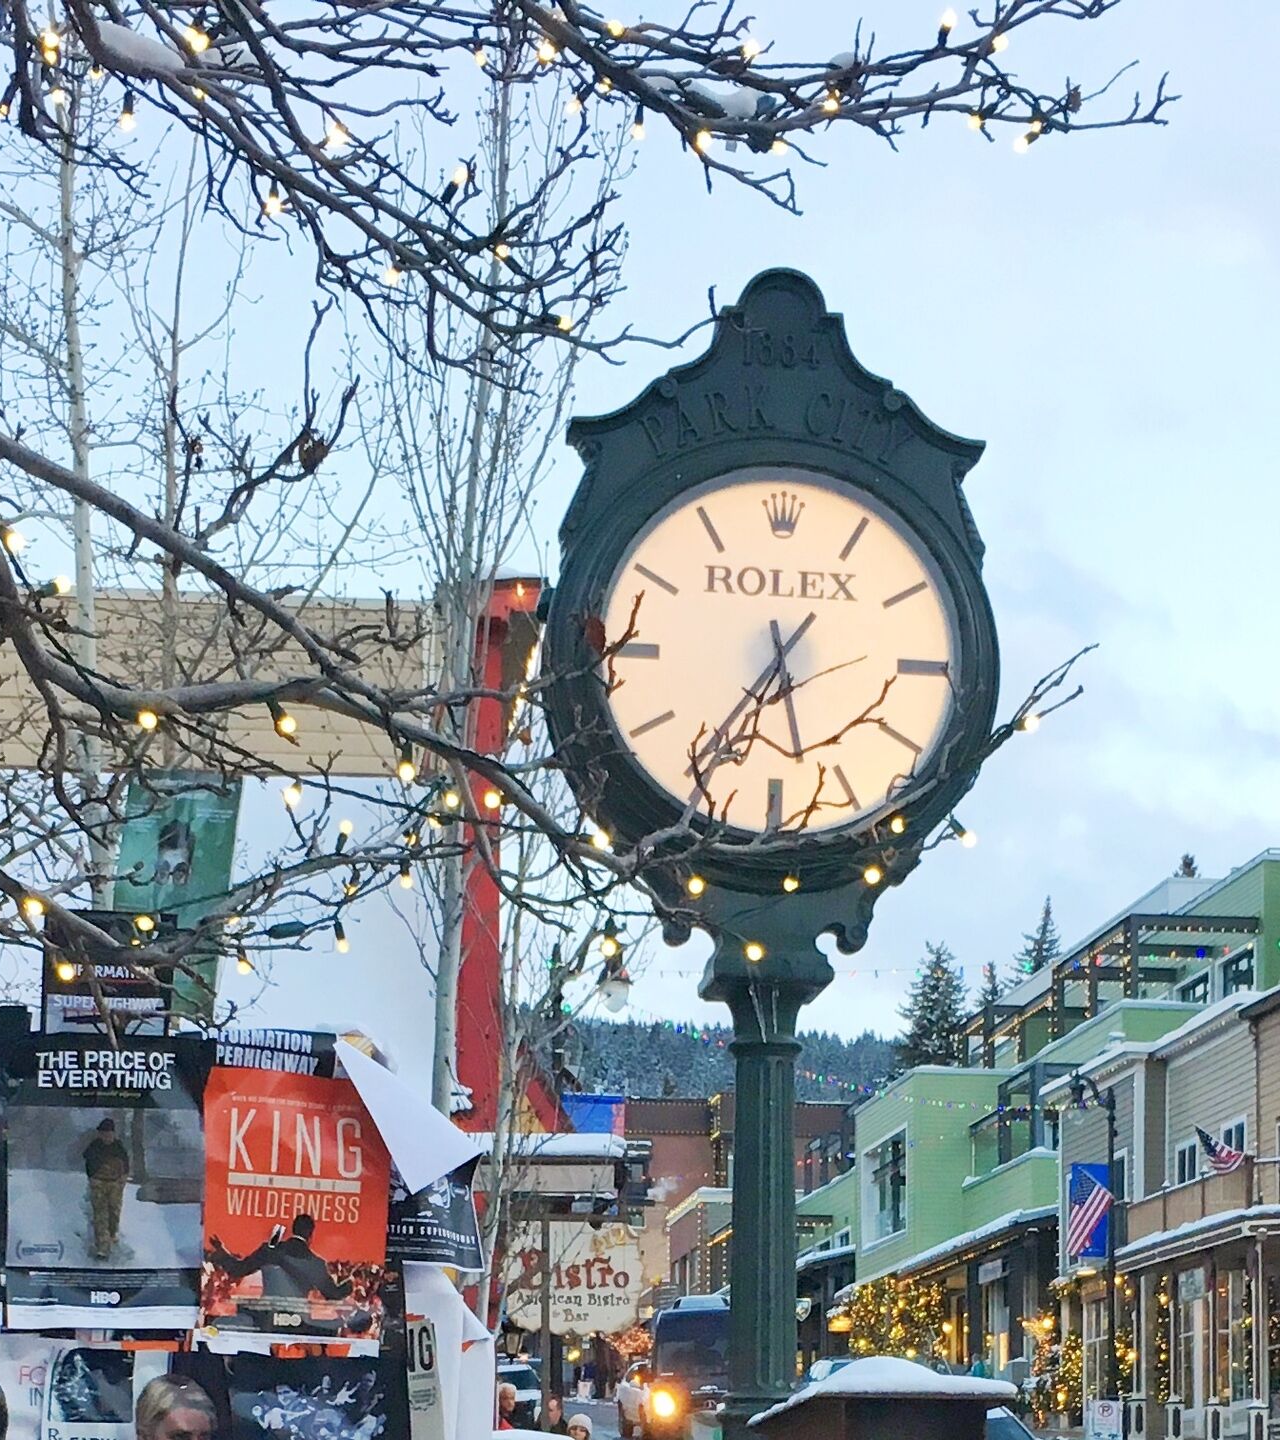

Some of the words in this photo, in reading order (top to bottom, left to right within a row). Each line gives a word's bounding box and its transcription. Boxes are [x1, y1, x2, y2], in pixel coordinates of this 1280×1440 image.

[741, 331, 820, 371] 1884
[636, 386, 775, 459] PARK
[805, 390, 917, 464] CITY
[703, 565, 858, 602] ROLEX
[36, 1051, 79, 1070] THE
[85, 1051, 147, 1071] PRICE
[148, 1053, 176, 1072] OF
[38, 1069, 173, 1090] EVERYTHING
[228, 1107, 363, 1179] KING
[226, 1187, 361, 1224] WILDERNESS
[90, 1290, 120, 1305] HBO
[587, 1292, 630, 1307] Bistro
[272, 1312, 302, 1328] HBO
[563, 1308, 589, 1322] Bar
